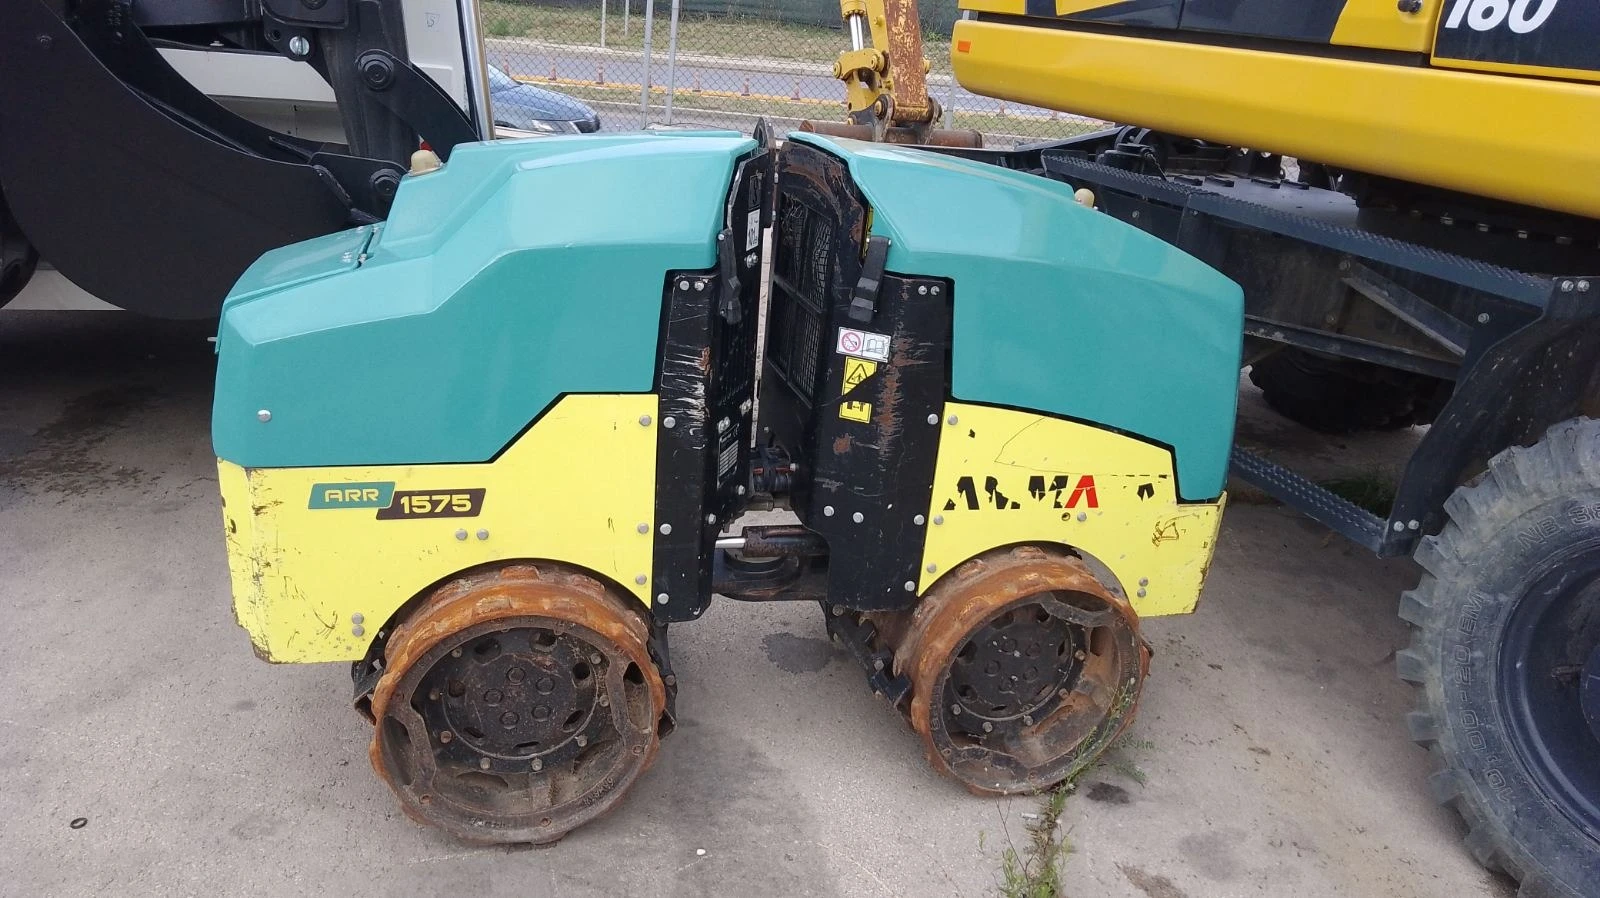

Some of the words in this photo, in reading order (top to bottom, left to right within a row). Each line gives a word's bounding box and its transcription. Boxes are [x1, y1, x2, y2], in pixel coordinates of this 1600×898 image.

[1445, 0, 1558, 34] 160
[324, 488, 379, 504] ARR
[400, 494, 472, 514] 1575
